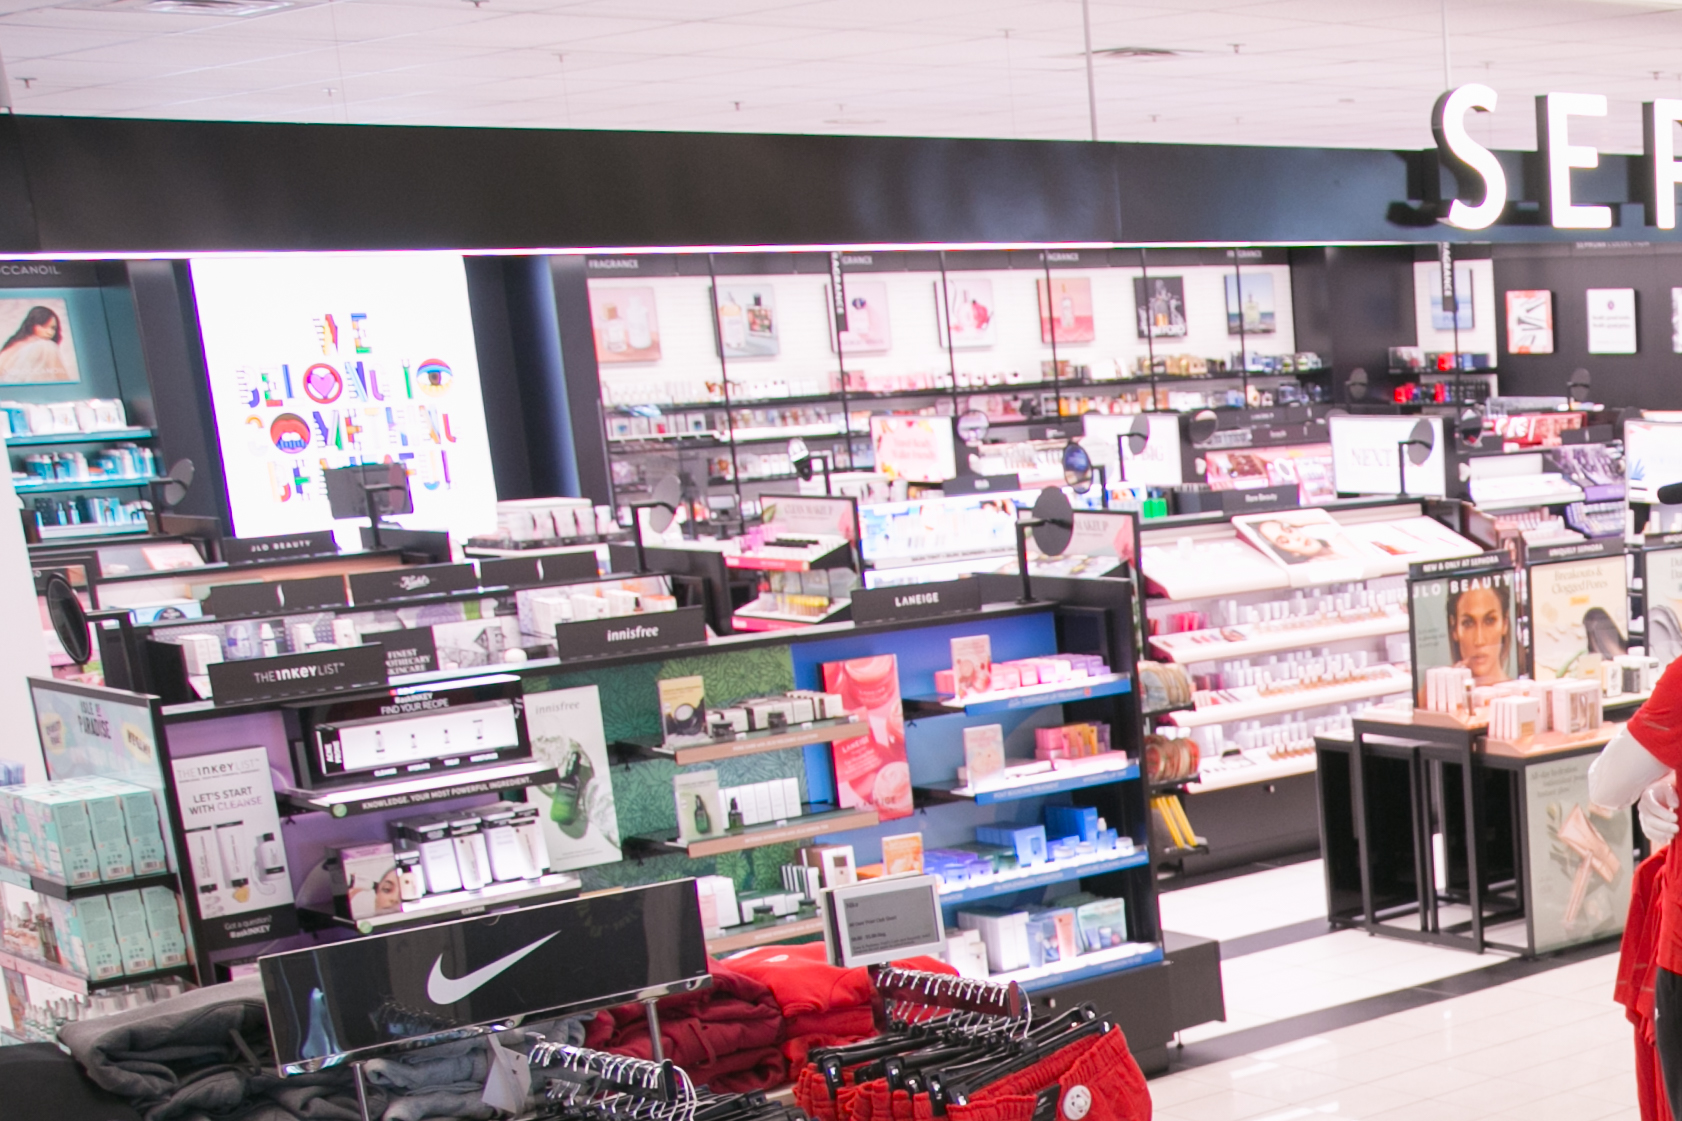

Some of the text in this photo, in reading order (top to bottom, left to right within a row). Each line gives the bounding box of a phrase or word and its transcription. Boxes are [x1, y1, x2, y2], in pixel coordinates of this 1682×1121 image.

[842, 255, 872, 265] GRANCE
[1040, 252, 1079, 262] FAGRANCE
[0, 264, 61, 276] CCANOIL
[588, 259, 639, 270] FRAGRANCE
[1450, 573, 1512, 594] BEAUTY
[895, 592, 940, 607] LANEIGE
[607, 625, 660, 642] innisfree
[381, 705, 401, 716] FIND
[401, 702, 422, 714] YOUR
[535, 701, 581, 715] innisfree
[77, 715, 112, 740] PARADISE
[193, 786, 253, 804] LET'S START
[189, 796, 263, 816] WITH CLEANSE
